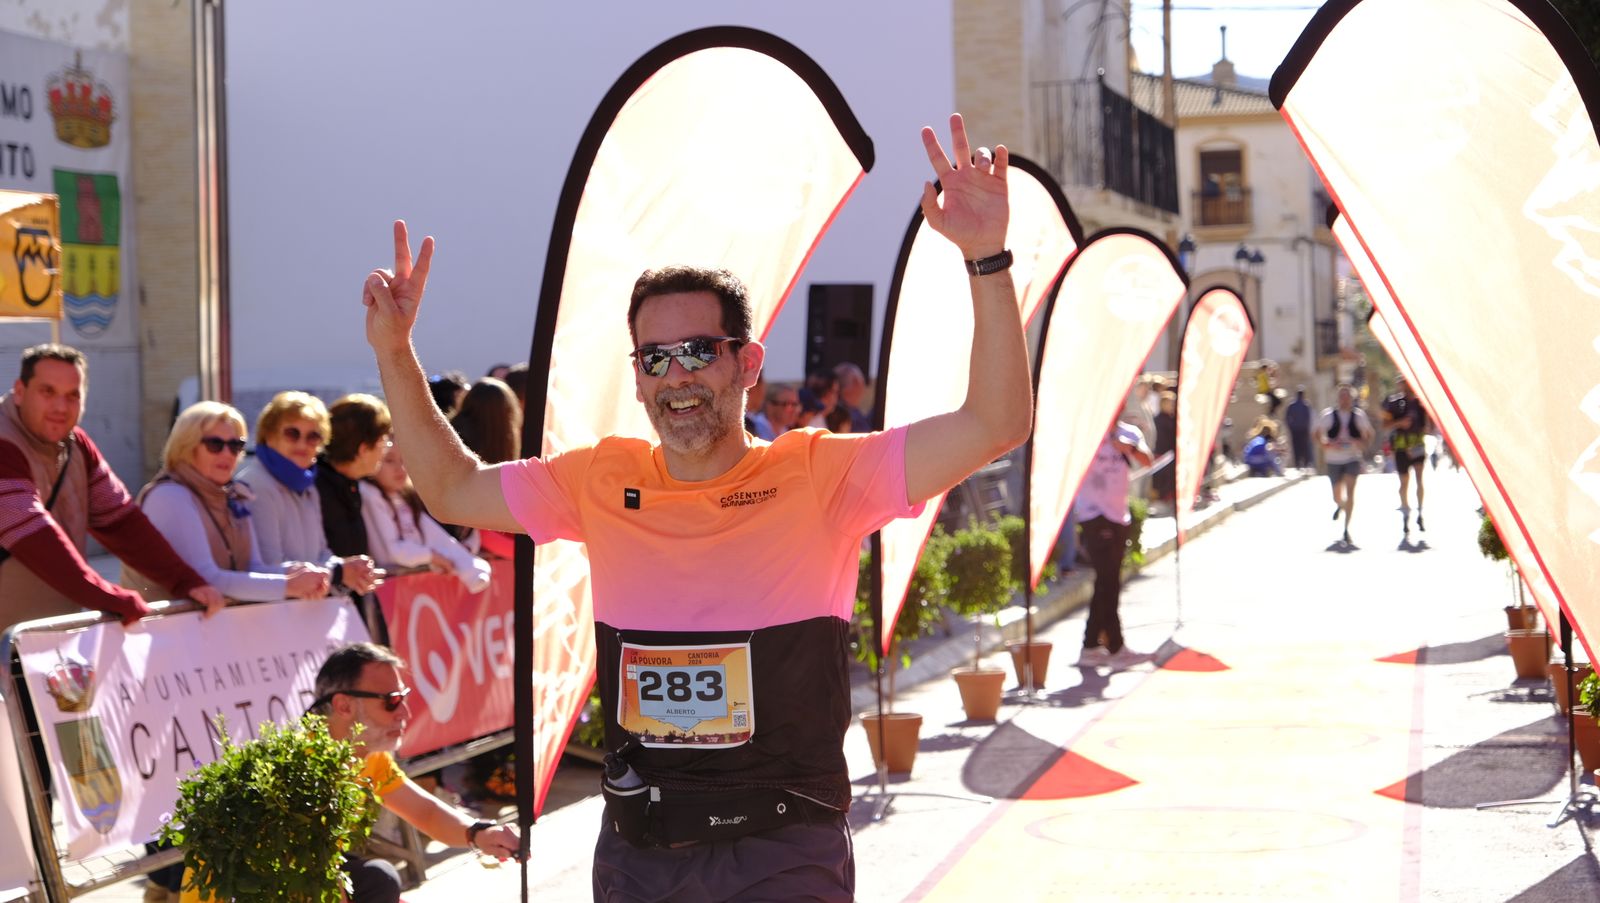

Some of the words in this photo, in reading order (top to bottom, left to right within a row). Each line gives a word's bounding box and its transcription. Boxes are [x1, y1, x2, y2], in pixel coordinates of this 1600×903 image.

[0, 142, 35, 179] TO
[720, 487, 777, 504] COSENTINO
[688, 651, 720, 659] CANTORIA
[117, 648, 315, 707] AYUNTAMIENTO
[639, 670, 724, 702] 283
